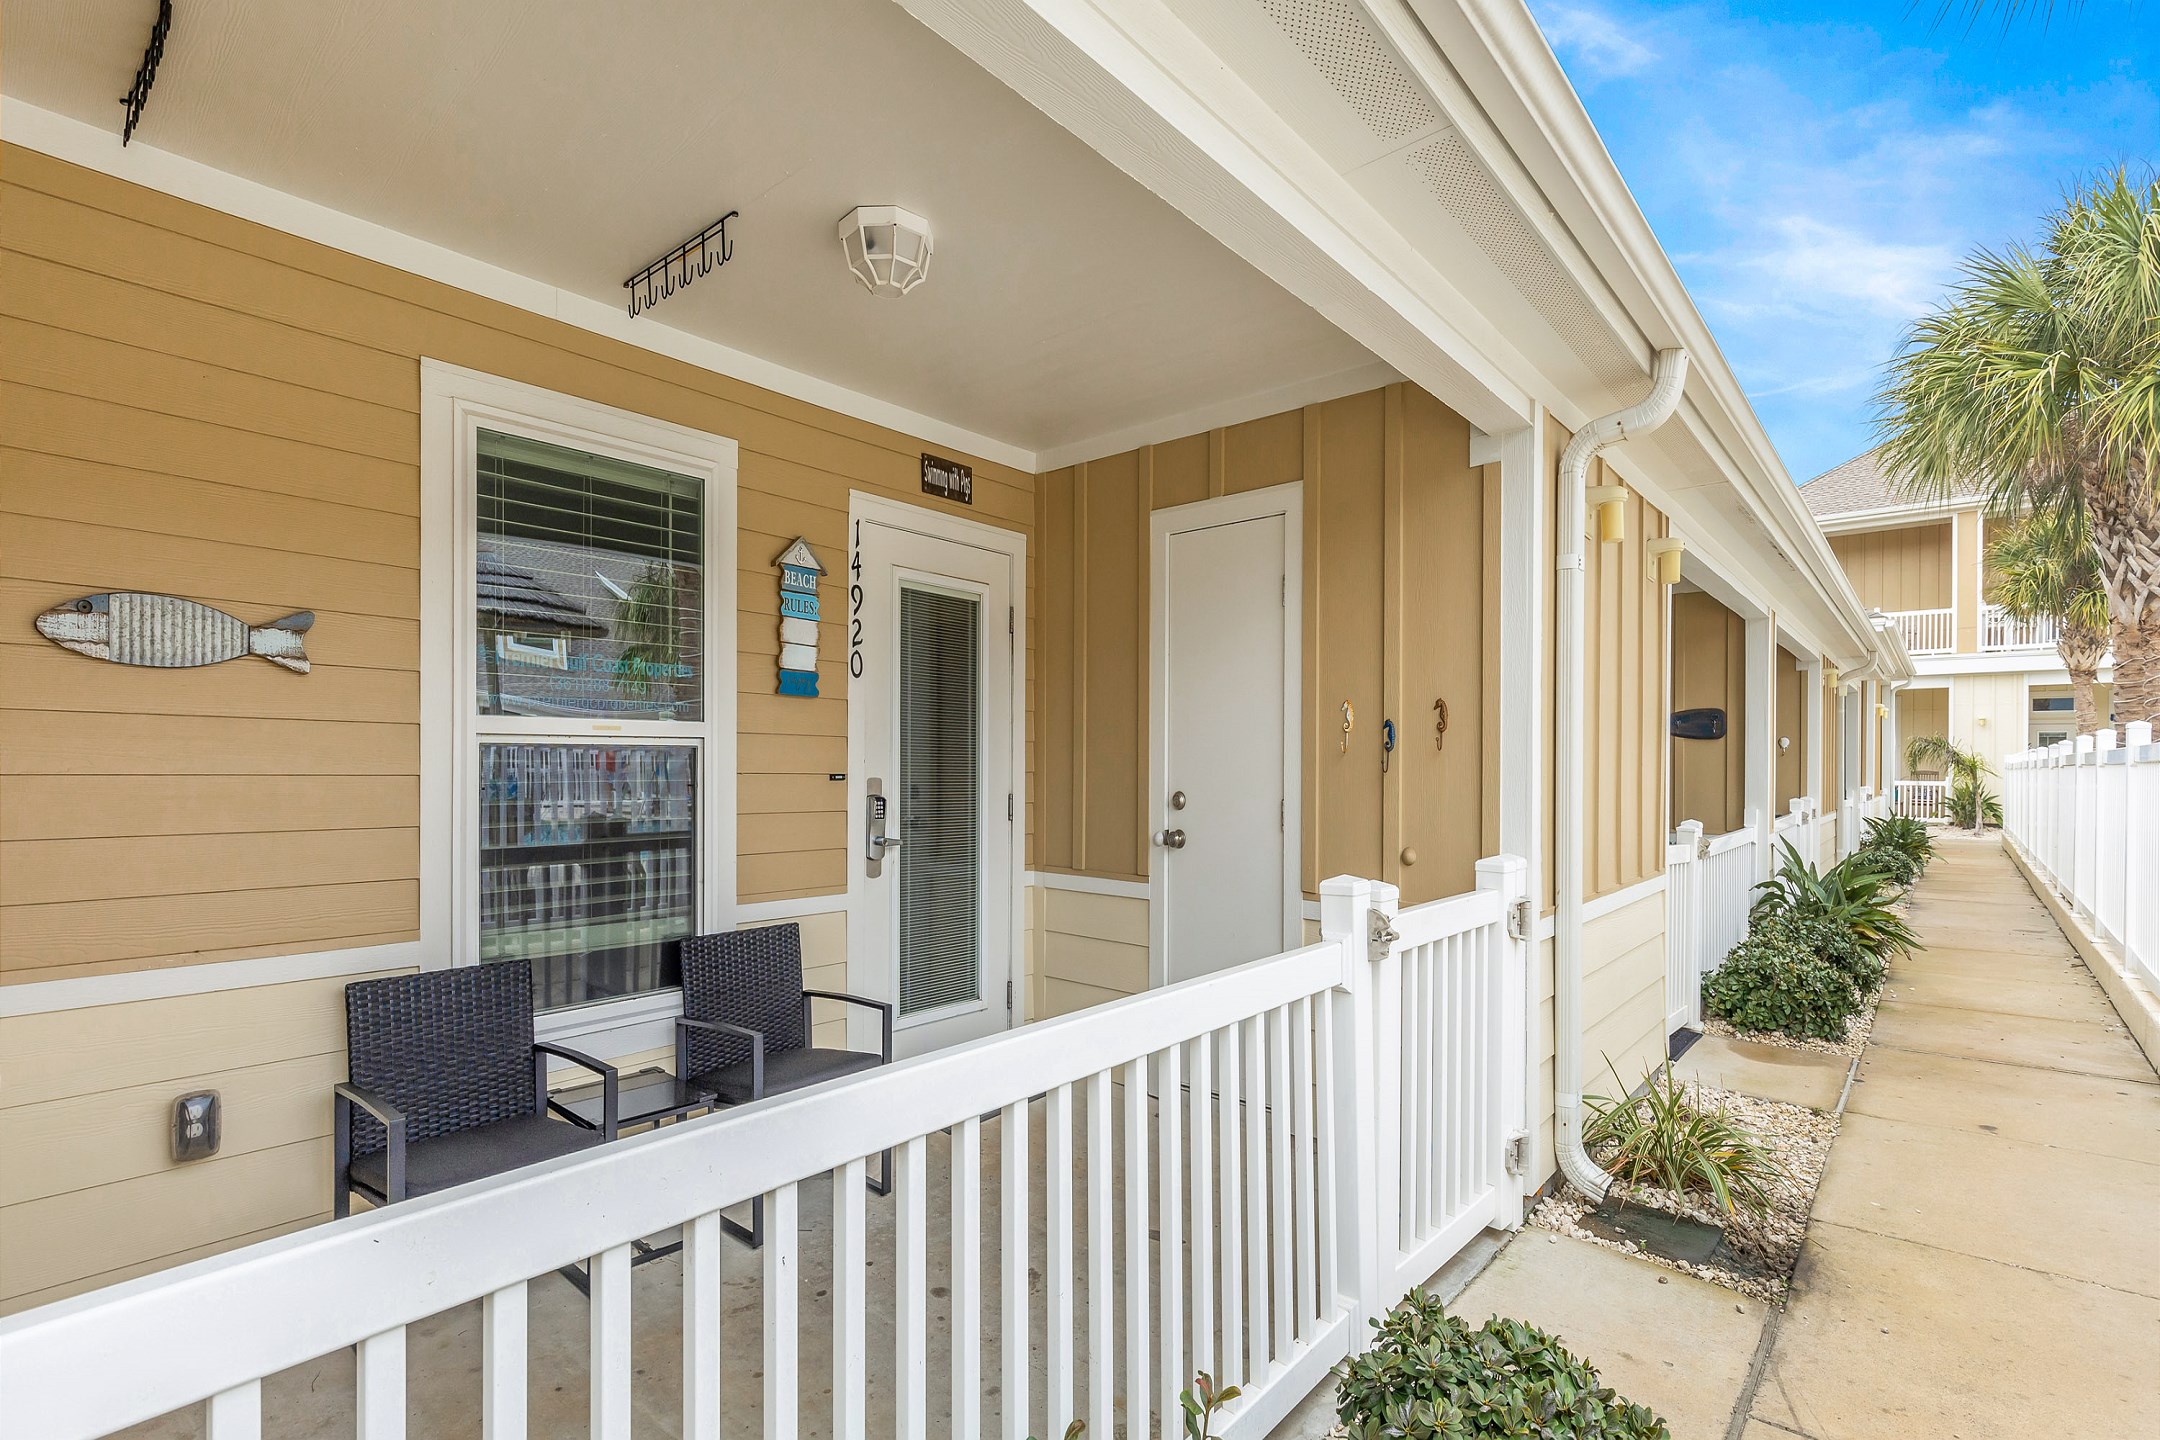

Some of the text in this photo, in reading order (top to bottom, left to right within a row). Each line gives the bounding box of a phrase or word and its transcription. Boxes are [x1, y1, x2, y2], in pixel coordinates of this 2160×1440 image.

[924, 460, 948, 496] Swimming
[949, 467, 959, 491] with
[784, 569, 817, 590] BEACH
[784, 597, 817, 616] RULES:
[850, 518, 863, 679] 14920
[592, 652, 630, 674] Coast
[633, 657, 693, 680] Properties
